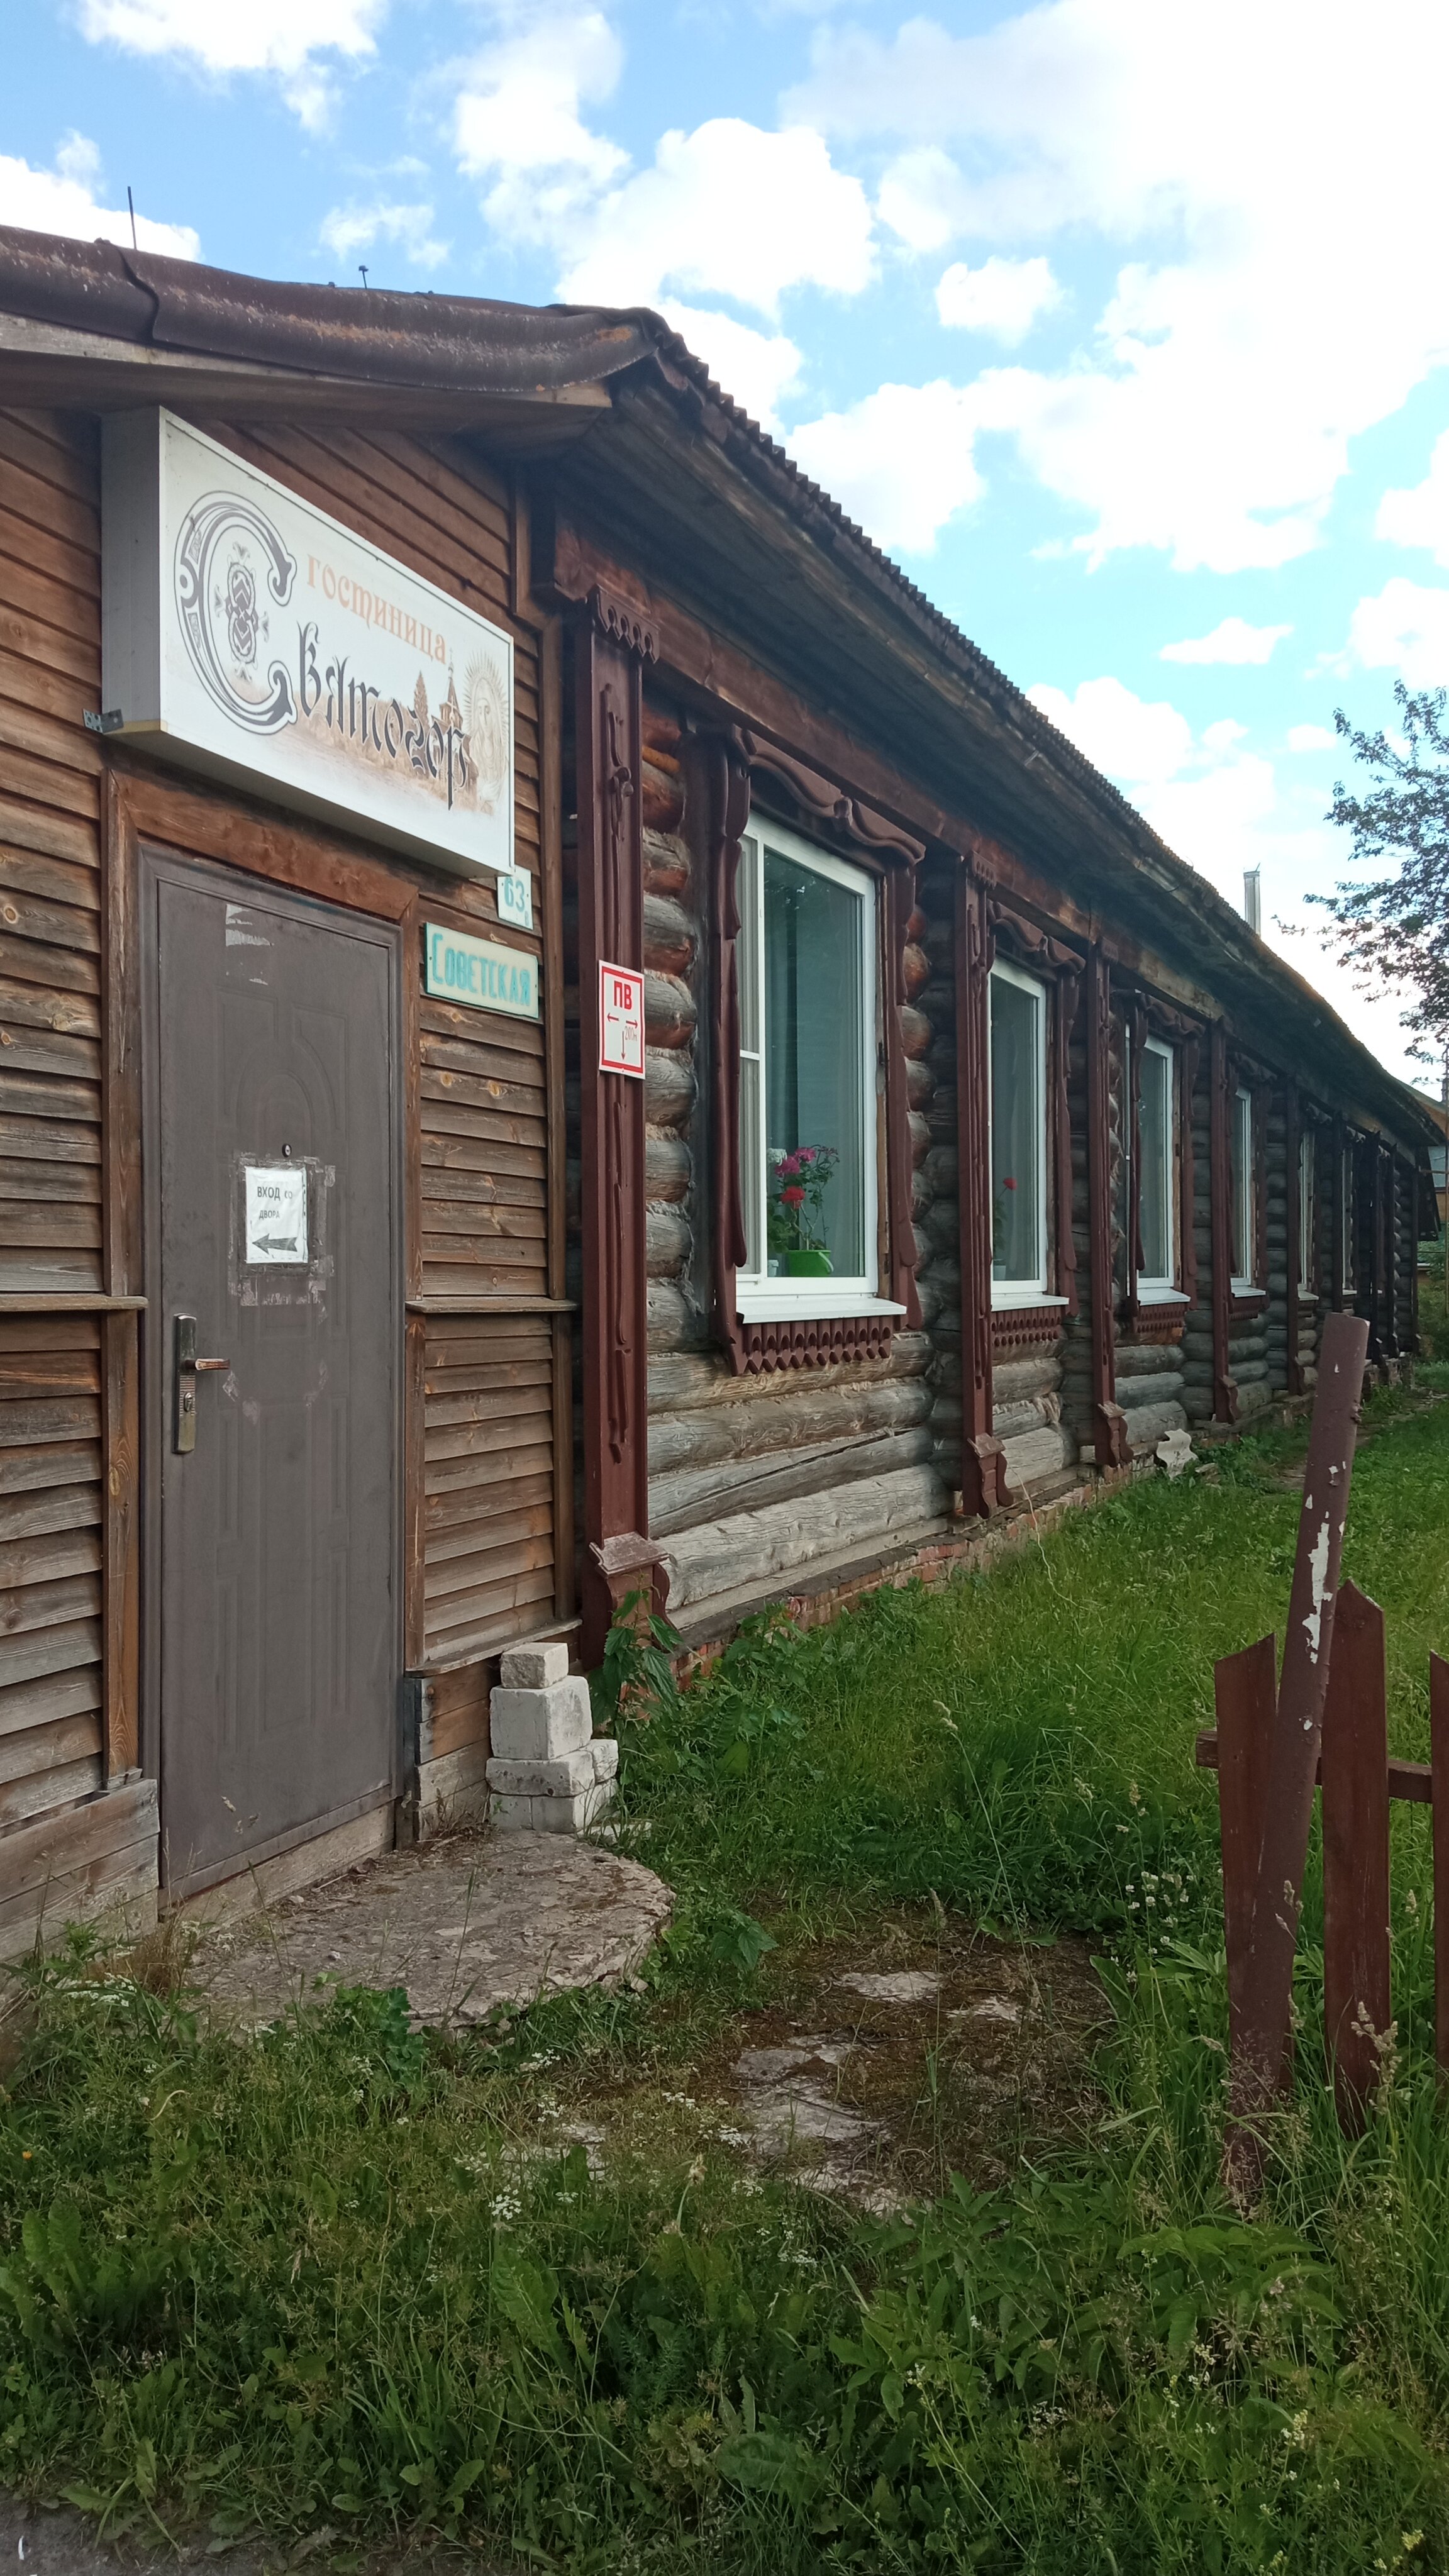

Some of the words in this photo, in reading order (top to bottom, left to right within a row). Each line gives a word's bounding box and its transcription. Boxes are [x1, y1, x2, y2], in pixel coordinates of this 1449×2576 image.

[504, 875, 525, 913] 63
[614, 980, 632, 1010] ПВ
[257, 1186, 280, 1201] ВХОД
[258, 1210, 280, 1220] ДВОРА
